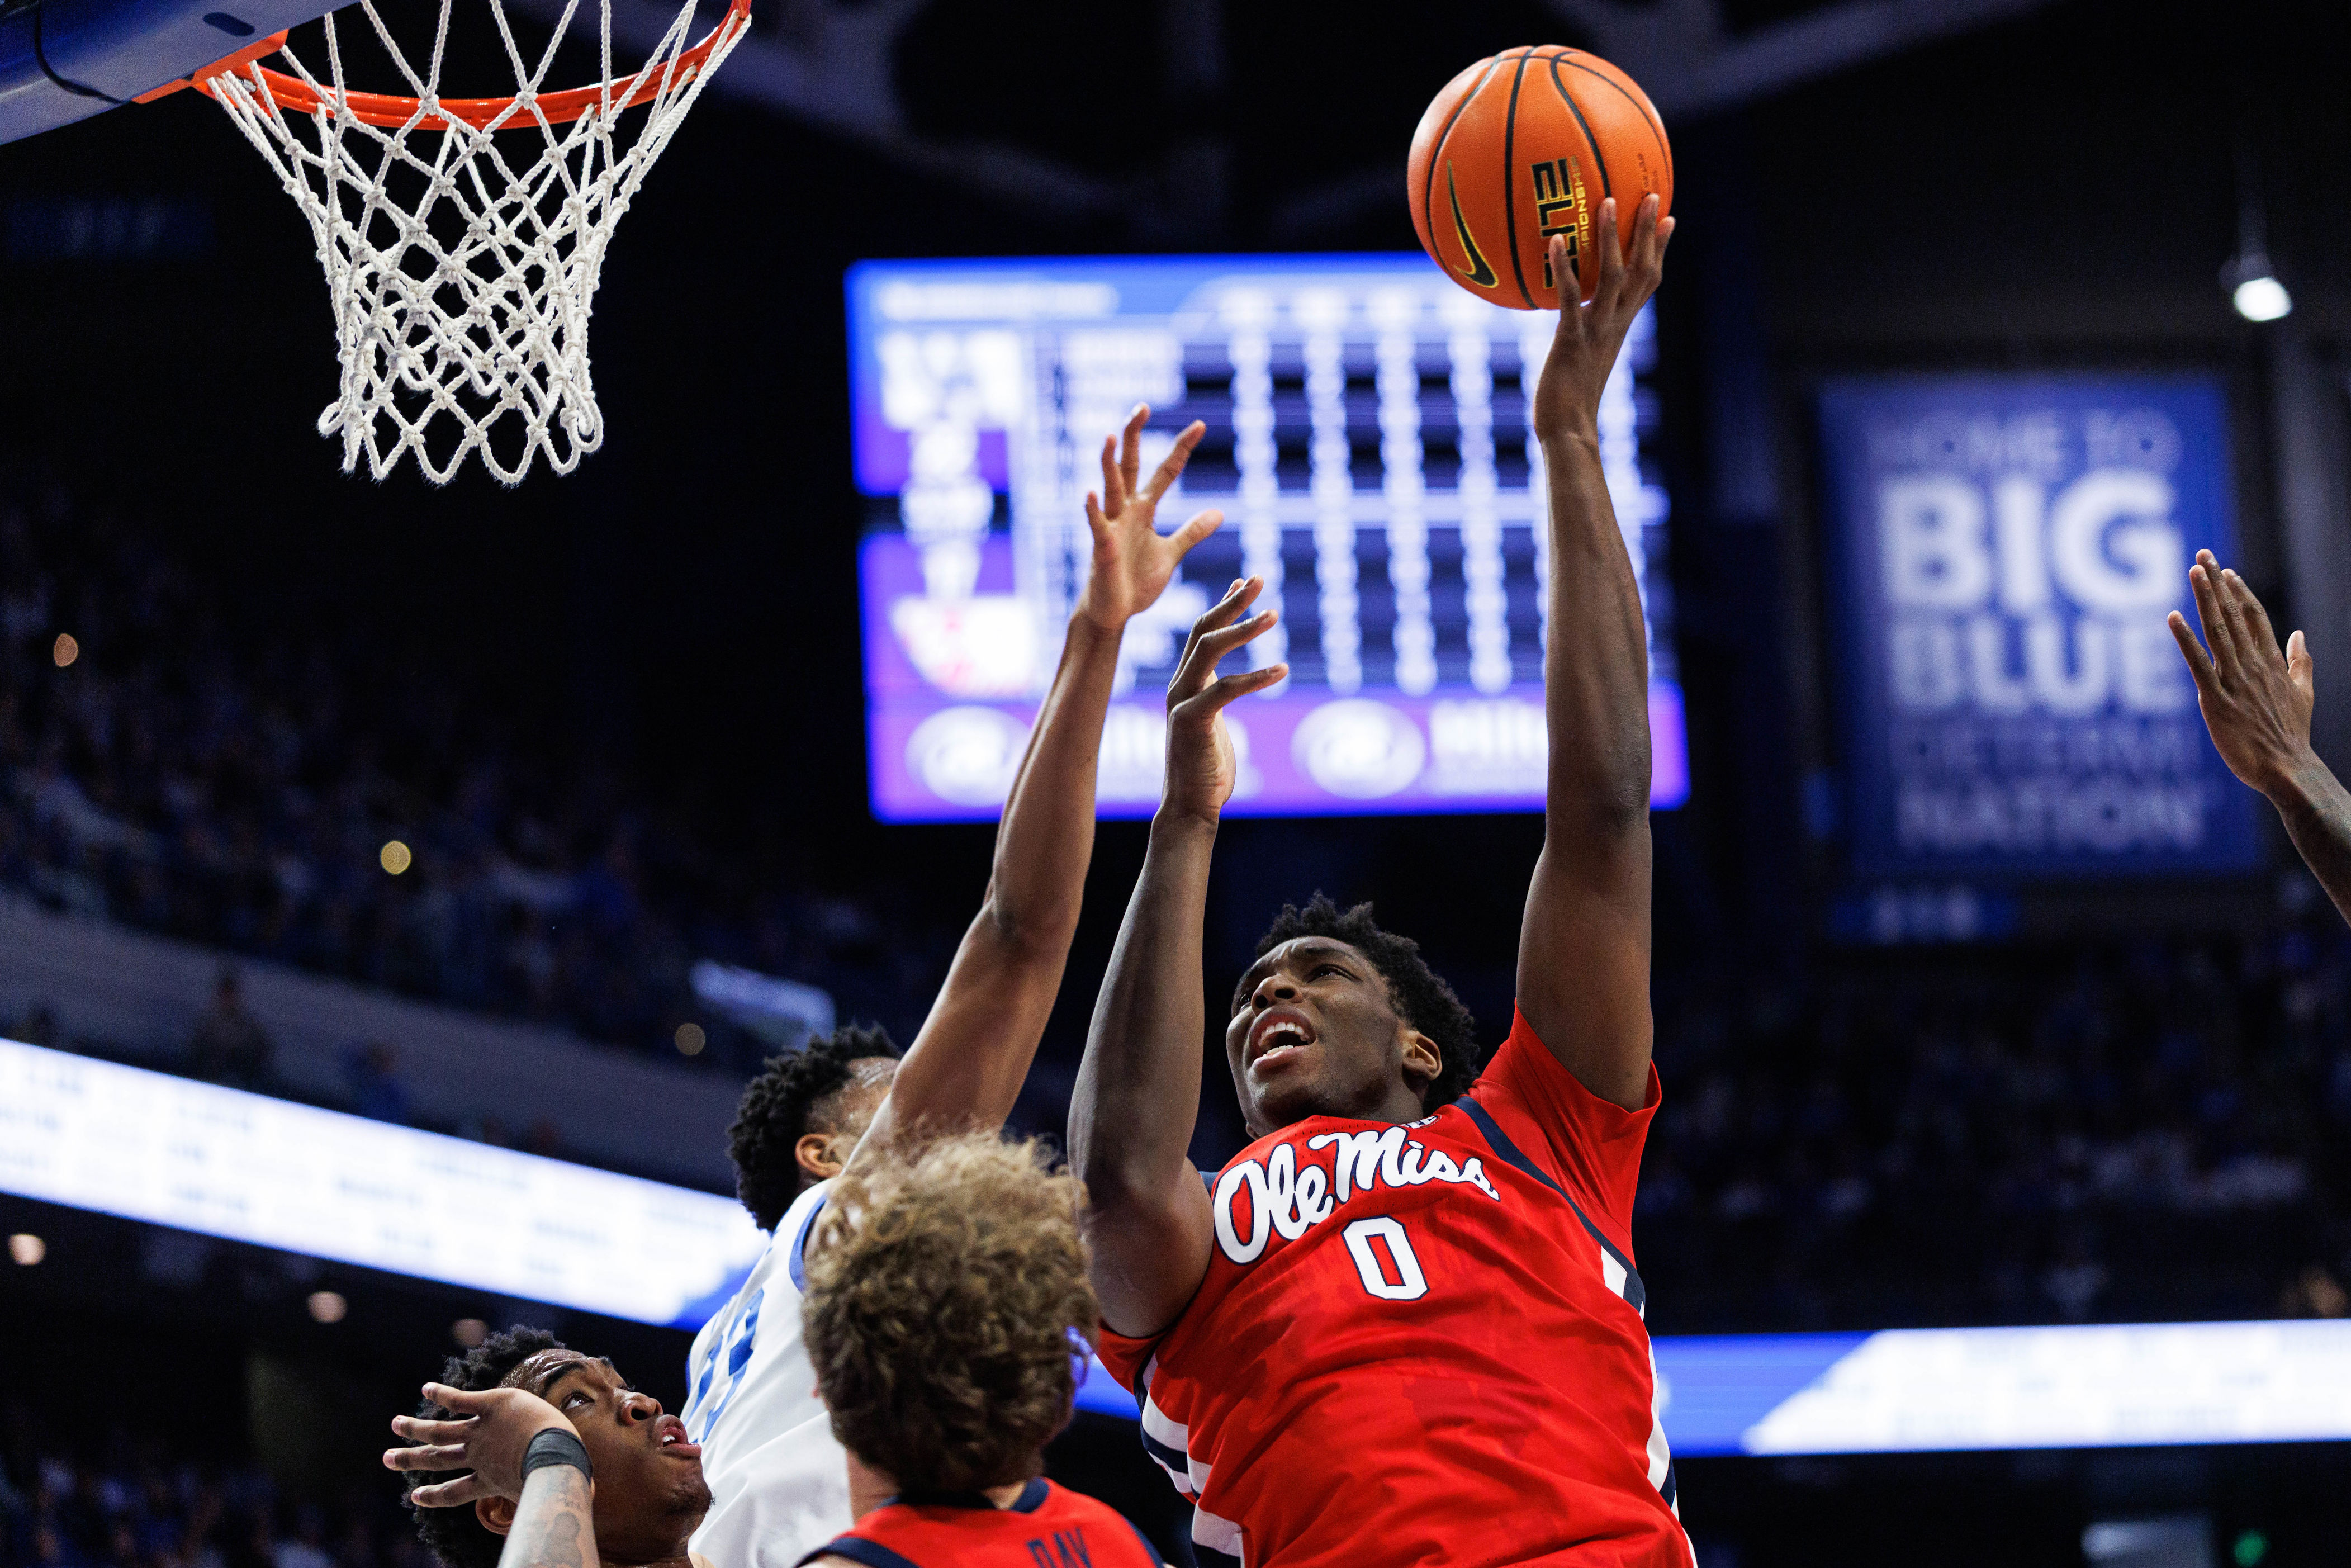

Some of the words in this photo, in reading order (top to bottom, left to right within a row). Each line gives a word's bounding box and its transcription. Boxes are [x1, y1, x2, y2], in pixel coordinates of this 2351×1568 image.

[1880, 471, 2184, 614] BIG
[1888, 615, 2188, 714] BLUE
[1896, 780, 2203, 852] NATION
[1214, 1143, 1334, 1266] Ole
[1307, 1126, 1500, 1204] Miss
[1342, 1215, 1430, 1301] 0
